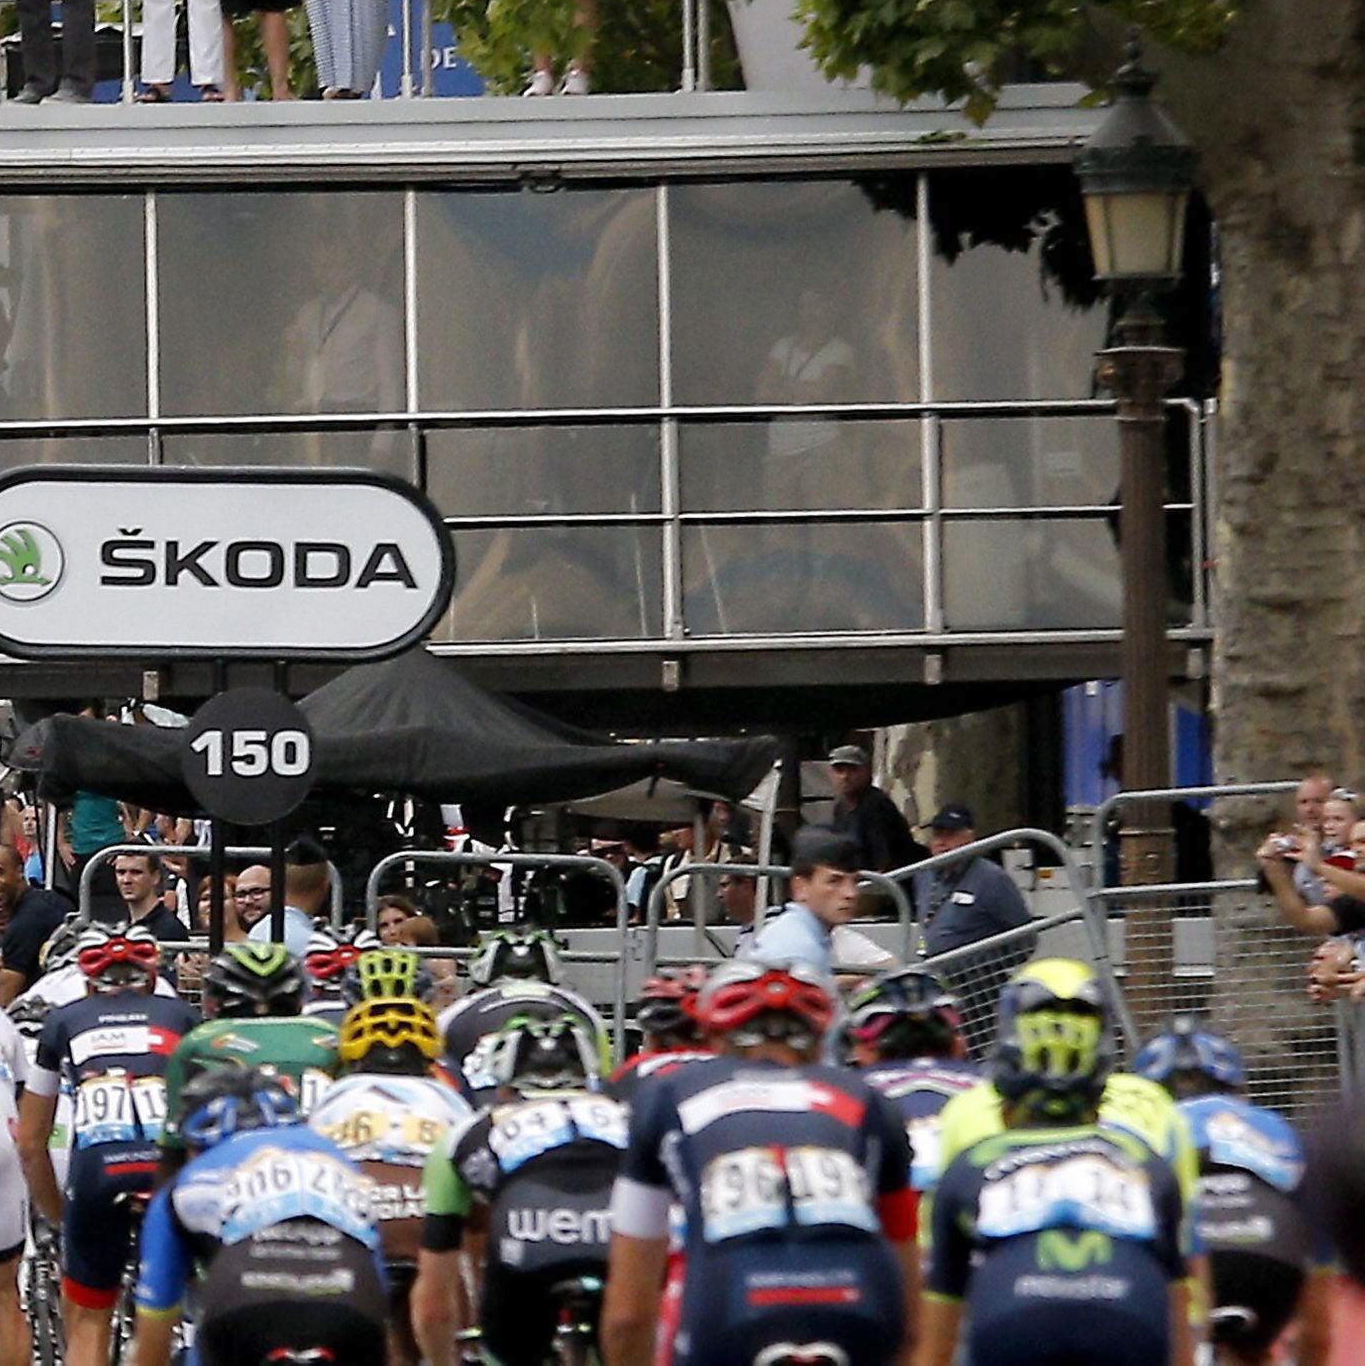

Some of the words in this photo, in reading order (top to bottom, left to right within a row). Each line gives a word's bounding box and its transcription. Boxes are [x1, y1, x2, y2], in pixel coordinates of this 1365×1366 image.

[99, 528, 419, 590] ŠKODA
[189, 729, 311, 778] 150
[81, 1085, 127, 1128] 197
